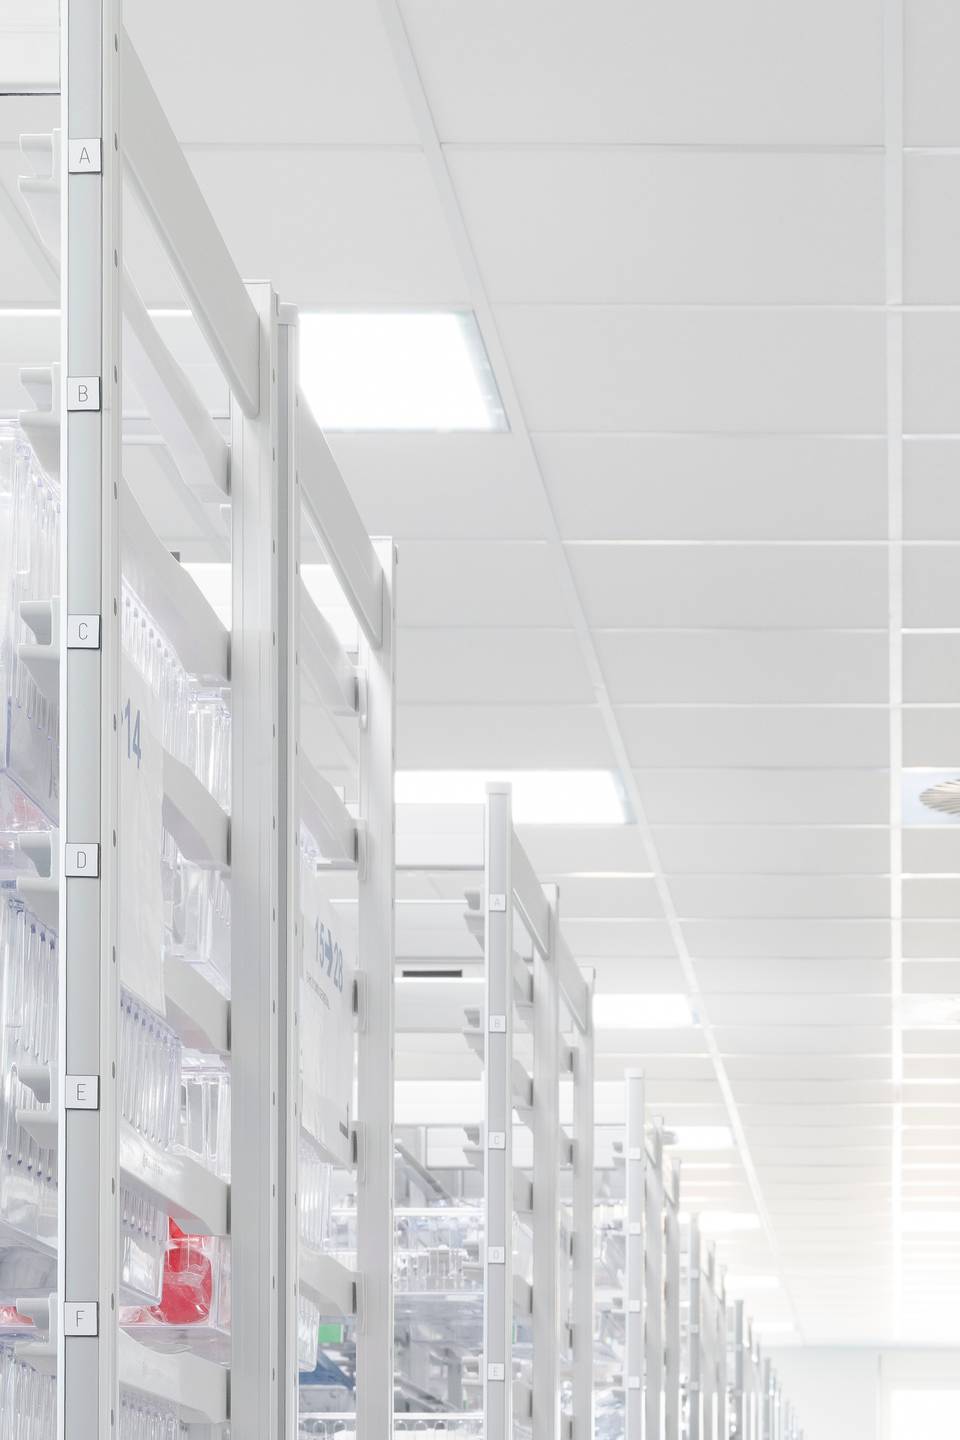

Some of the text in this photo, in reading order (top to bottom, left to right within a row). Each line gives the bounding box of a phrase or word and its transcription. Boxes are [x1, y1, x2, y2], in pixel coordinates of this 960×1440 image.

[80, 146, 91, 164] A
[79, 385, 88, 402] B
[79, 623, 87, 640] C
[77, 852, 86, 868] D
[77, 1084, 86, 1100] E
[77, 1311, 85, 1328] F
